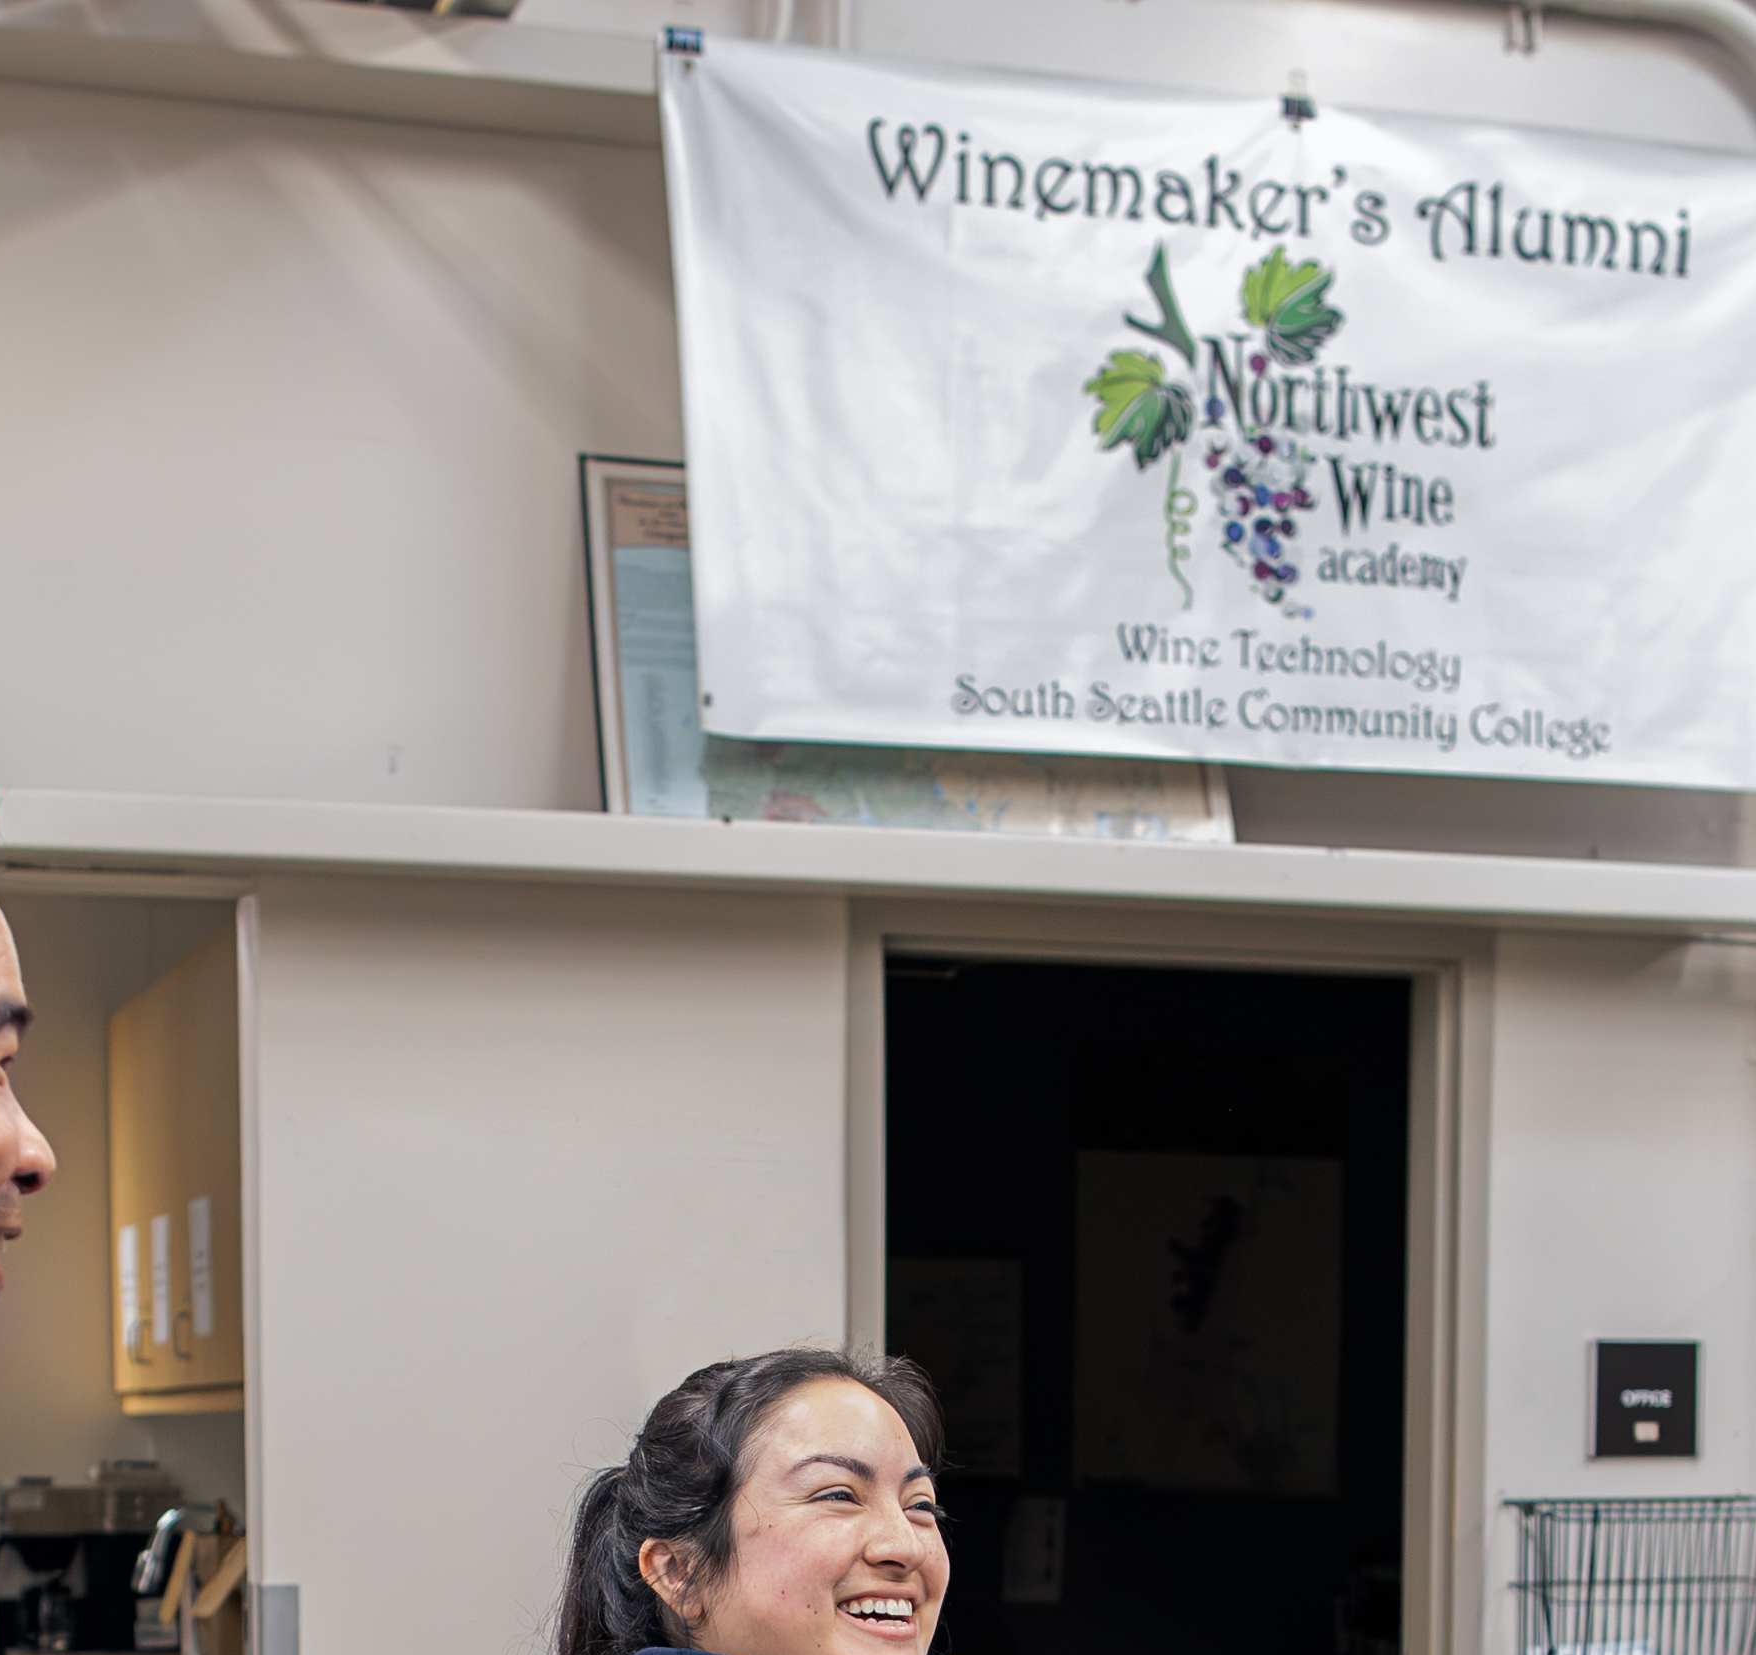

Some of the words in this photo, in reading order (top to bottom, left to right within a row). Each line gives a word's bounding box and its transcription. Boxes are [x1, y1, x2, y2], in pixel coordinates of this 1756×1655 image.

[868, 117, 1390, 245] Winemaker's
[1416, 180, 1691, 278] Alumni
[1202, 333, 1495, 450] Northwest
[1326, 454, 1454, 536] Wine
[1317, 543, 1466, 602] academy
[1116, 623, 1221, 667] Wine
[1230, 628, 1461, 694] Technology
[950, 673, 1076, 719] South
[1087, 681, 1227, 729] Seattle
[1237, 687, 1458, 753] Community
[1469, 701, 1612, 761] College
[1620, 1388, 1673, 1408] OFFICE
